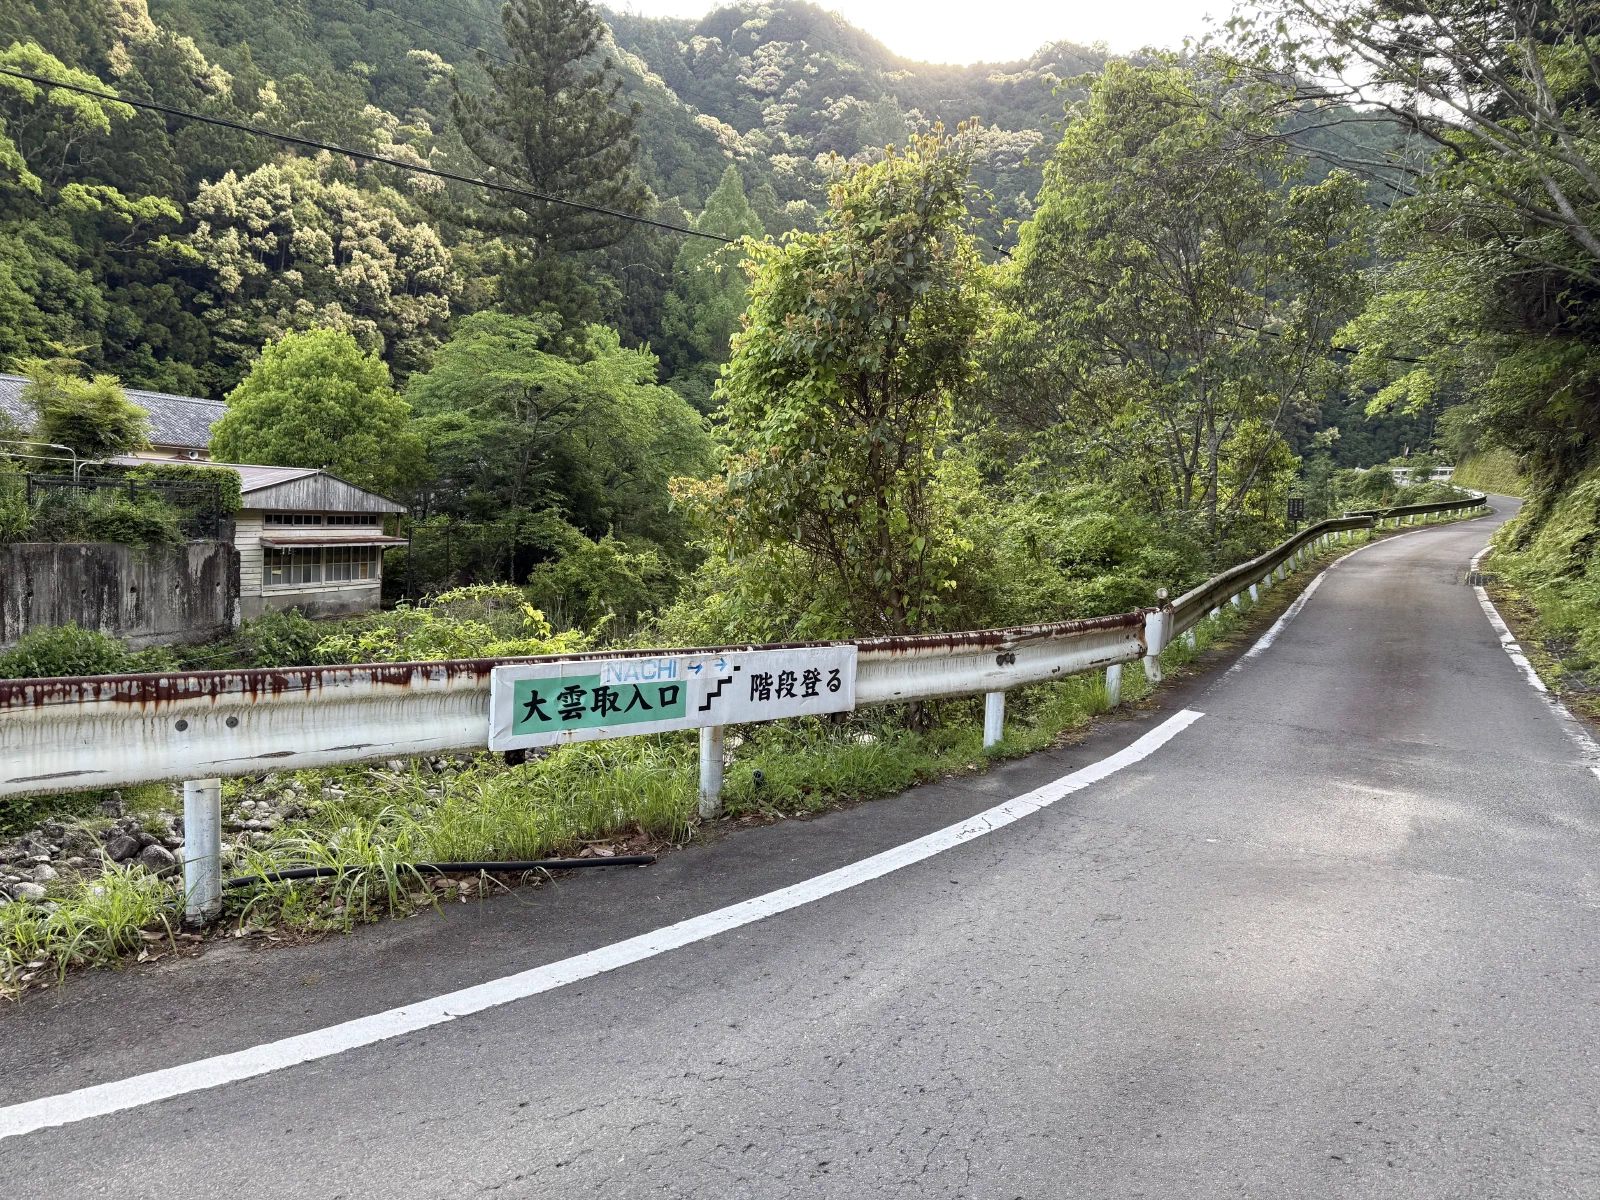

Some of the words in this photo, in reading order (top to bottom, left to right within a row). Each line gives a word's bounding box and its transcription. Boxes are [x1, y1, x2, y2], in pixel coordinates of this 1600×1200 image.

[606, 658, 677, 683] NACHI
[749, 667, 842, 702] 階段登る
[520, 683, 680, 724] 大雲取入口
